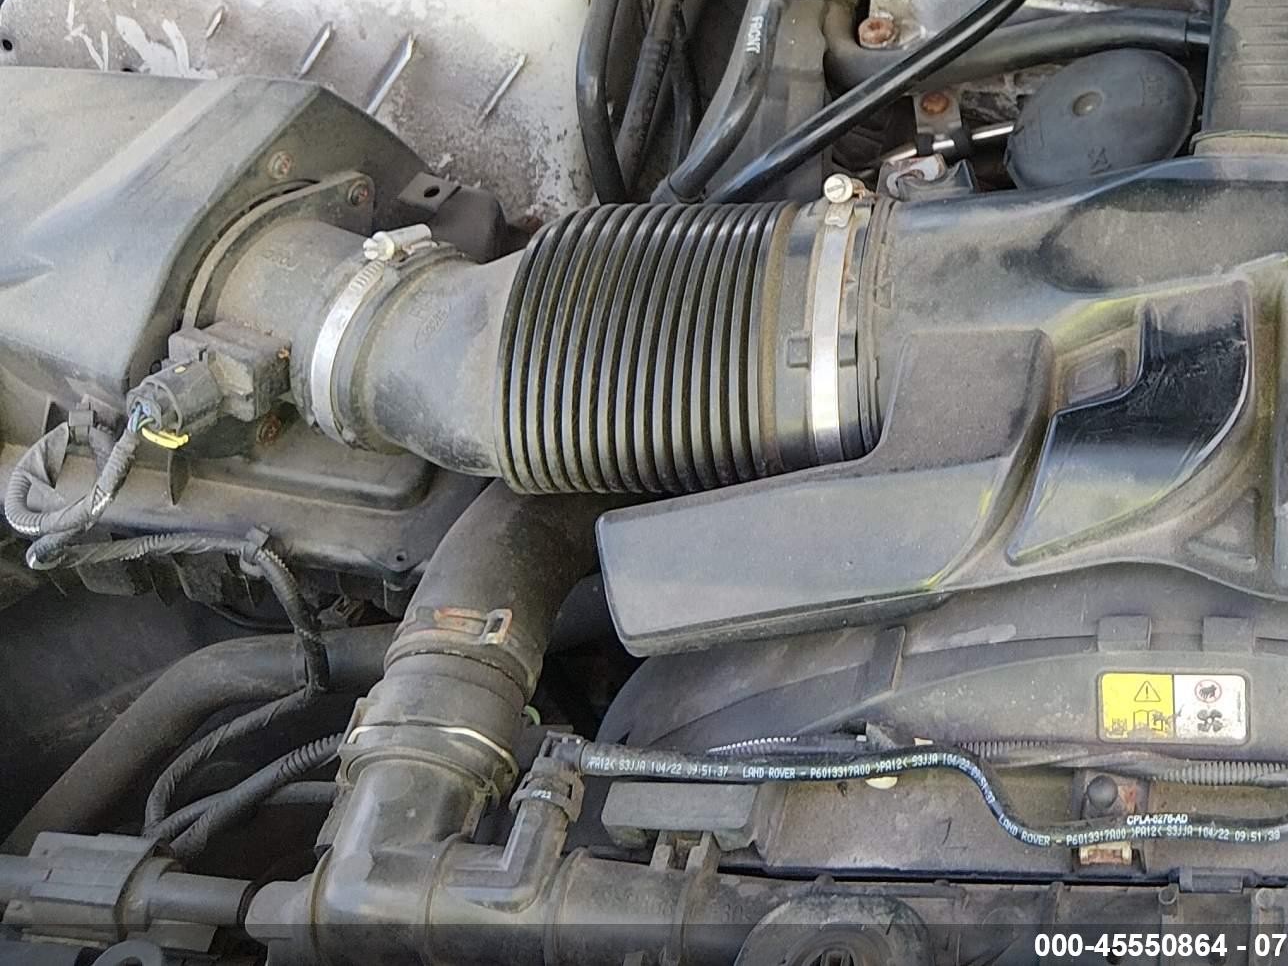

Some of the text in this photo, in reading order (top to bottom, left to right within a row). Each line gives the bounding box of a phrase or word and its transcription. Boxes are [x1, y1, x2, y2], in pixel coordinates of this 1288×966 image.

[746, 15, 765, 54] FRONT
[742, 766, 765, 779] LAND
[768, 767, 796, 779] ROVER
[998, 813, 1019, 836] LAND
[1021, 830, 1051, 846] ROVER
